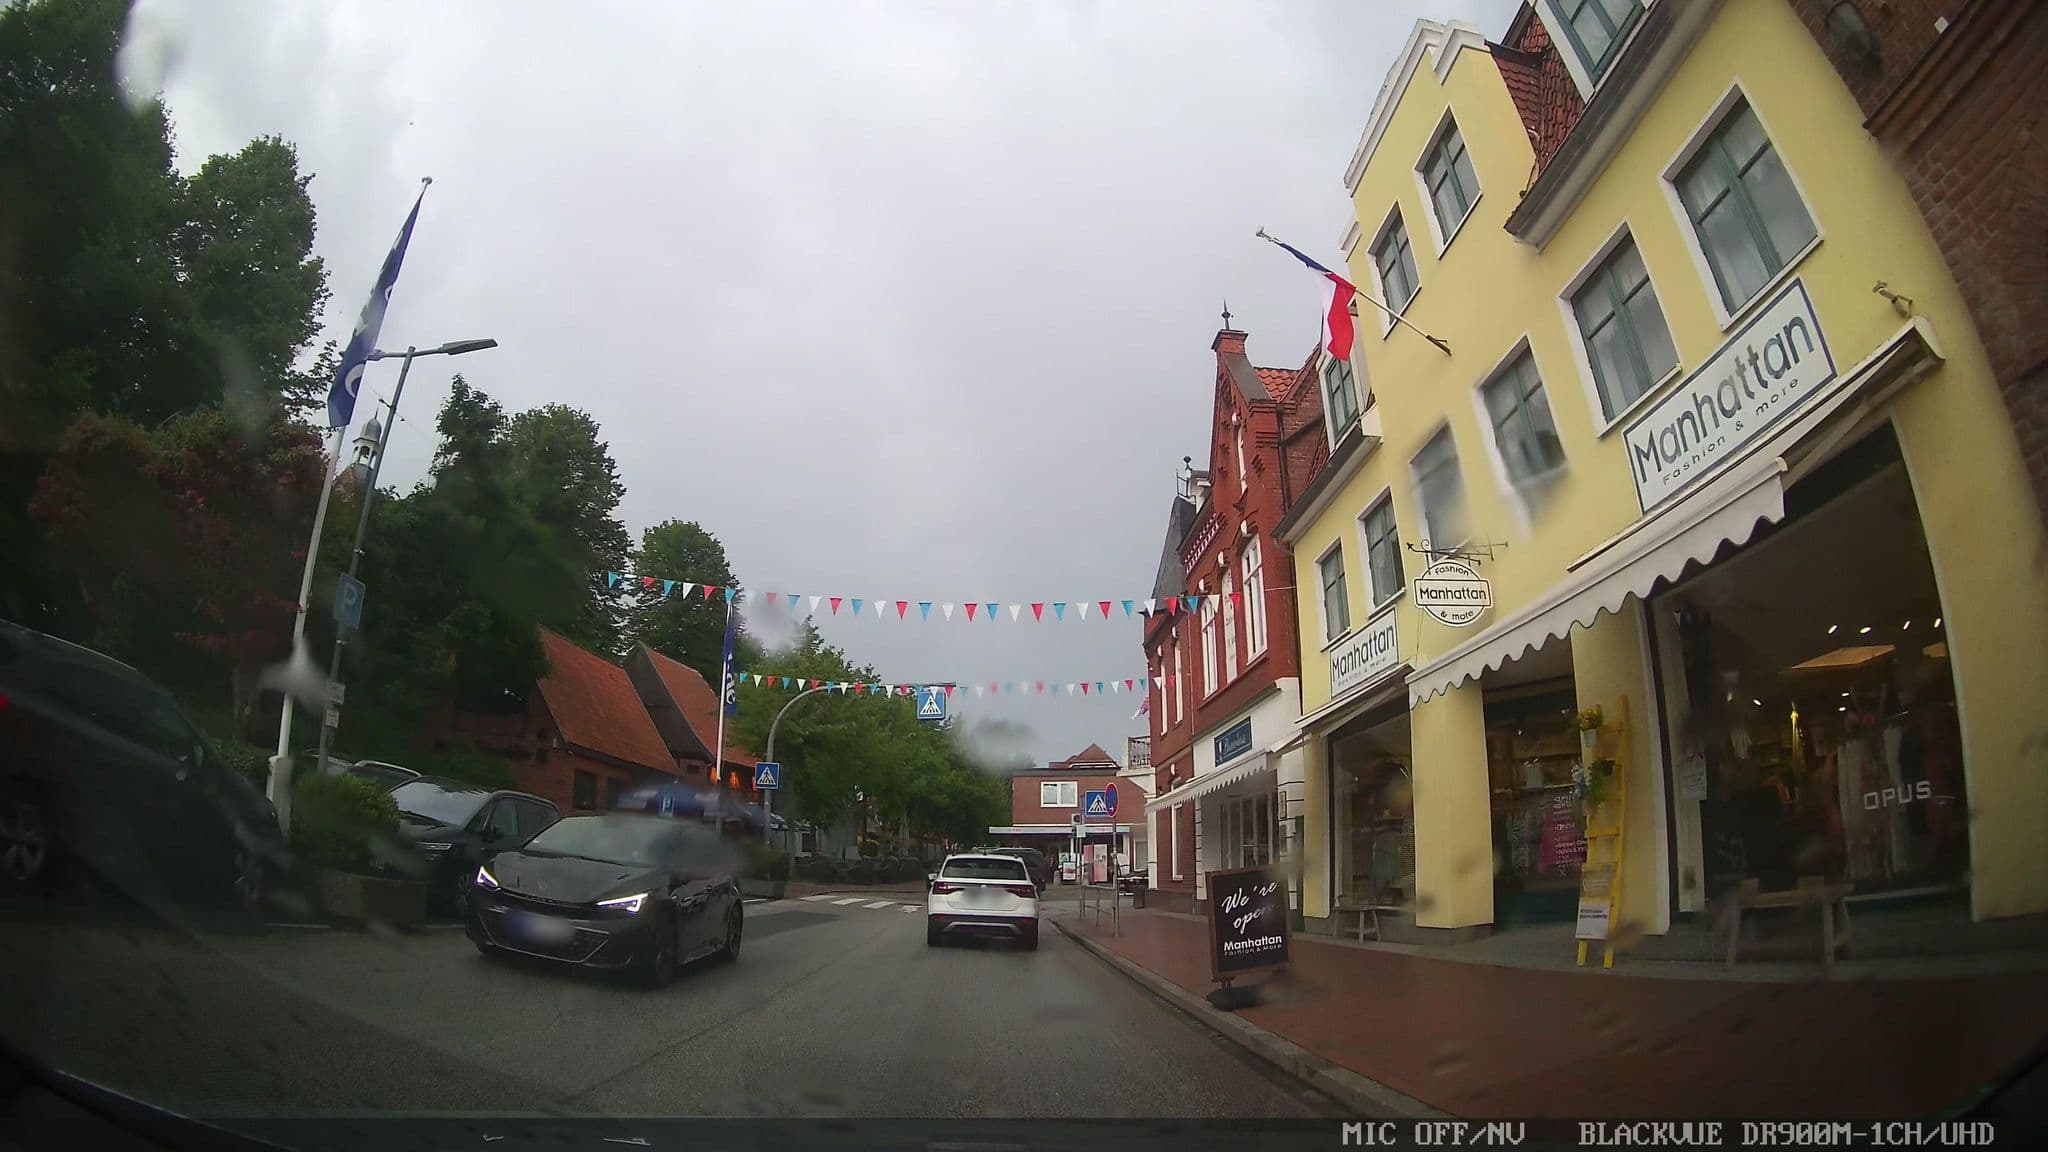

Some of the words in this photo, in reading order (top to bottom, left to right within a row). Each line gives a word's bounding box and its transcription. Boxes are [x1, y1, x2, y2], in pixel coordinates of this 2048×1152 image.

[1633, 316, 1814, 484] Manhattan
[1663, 436, 1726, 485] Fashion
[1735, 420, 1744, 431] &
[1755, 379, 1798, 416] more
[1420, 587, 1487, 600] Manhattan
[1332, 625, 1395, 681] Manhattan
[1864, 780, 1931, 810] OPUS
[1224, 935, 1282, 951] Manhattan
